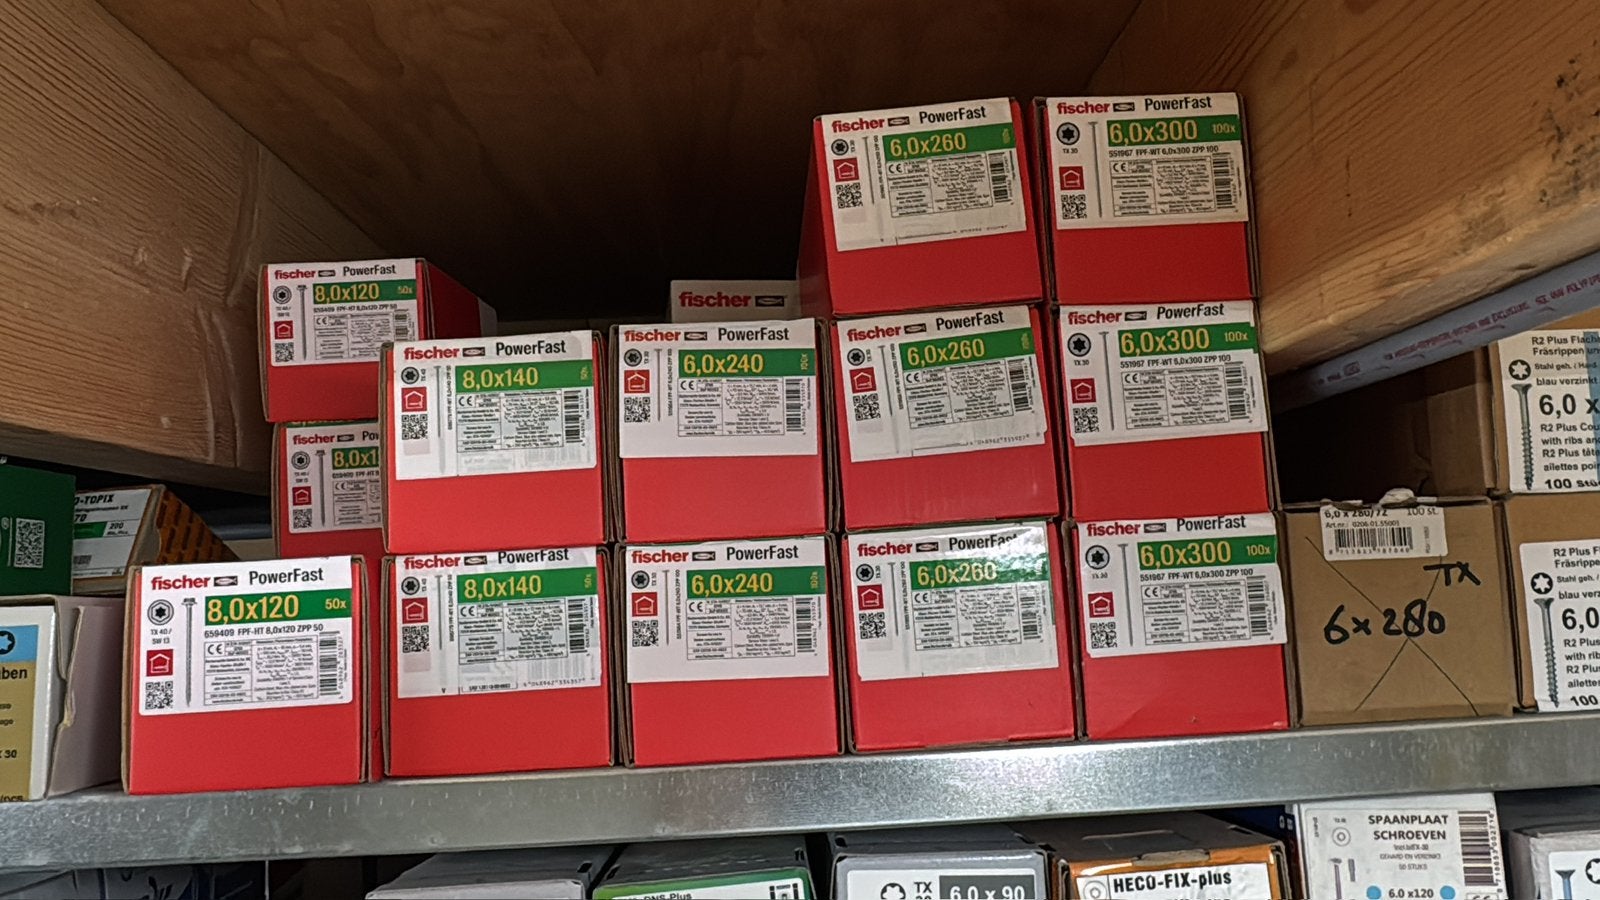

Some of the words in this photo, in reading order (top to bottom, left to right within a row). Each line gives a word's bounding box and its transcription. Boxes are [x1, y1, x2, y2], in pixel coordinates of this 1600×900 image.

[1057, 102, 1110, 114] fischer
[1145, 97, 1212, 111] PowerFast
[832, 118, 885, 133] fischer
[919, 107, 986, 124] PowerFast
[1109, 120, 1197, 146] 6,0x300
[1212, 123, 1235, 133] 100x
[890, 132, 966, 159] 6,0x260
[275, 269, 316, 279] fischer
[343, 265, 396, 276] PowerFast
[315, 283, 379, 303] 8,0x120
[679, 292, 751, 307] fischer
[1068, 311, 1122, 325] fischer
[1157, 304, 1224, 319] PowerFast
[847, 326, 901, 341] fischer
[936, 311, 1004, 330] PowerFast
[624, 330, 681, 341] fischer
[718, 328, 789, 341] PowerFast
[1532, 337, 1544, 345] R2
[1547, 336, 1568, 344] Plus
[404, 347, 459, 360] fischer
[496, 340, 566, 355] PowerFast
[1121, 328, 1210, 357] 6,0x300
[1224, 332, 1248, 342] 100x
[907, 339, 985, 366] 6,0x260
[1533, 347, 1584, 357] Fräsrippen
[684, 354, 763, 376] 6,0x240
[1204, 356, 1217, 364] ZPP
[463, 367, 538, 390] 8,0x140
[1559, 377, 1597, 385] verzinkt
[1539, 394, 1576, 418] 6,0
[1585, 399, 1599, 414] x
[1540, 424, 1553, 432] R2
[1556, 423, 1577, 431] Plus
[293, 434, 335, 445] fischer
[1541, 437, 1562, 445] with
[334, 449, 379, 468] 8,0x1
[1542, 449, 1555, 457] R2
[1559, 449, 1579, 457] Plus
[1544, 463, 1578, 471] ailettes
[1545, 479, 1572, 489] 100
[1324, 510, 1340, 519] 6,0
[1408, 507, 1424, 516] 100
[1087, 523, 1140, 536] fischer
[1177, 516, 1246, 532] PowerFast
[632, 550, 689, 563] fischer
[726, 545, 799, 560] PowerFast
[857, 542, 912, 557] fischer
[1141, 541, 1231, 569] 6,0x300
[1247, 545, 1270, 556] 100x
[1553, 548, 1566, 557] R2
[1569, 547, 1590, 556] Plus
[404, 555, 461, 570] fischer
[498, 549, 569, 564] PowerFast
[151, 575, 210, 590] fischer
[250, 568, 323, 585] PowerFast
[917, 562, 998, 588] 6,0x260
[1168, 572, 1193, 580] FPF-WT
[1226, 569, 1239, 577] ZPP
[1241, 568, 1253, 576] 100
[1423, 561, 1481, 586] TX
[1578, 575, 1594, 583] geh.
[464, 575, 541, 601] 8,0x140
[692, 573, 773, 597] 6,0x240
[1559, 590, 1579, 599] blau
[207, 595, 299, 625] 8,0x120
[325, 599, 346, 610] 50x
[1562, 607, 1599, 633] 6,0
[238, 627, 264, 636] FPF-HT
[266, 626, 295, 635] 8,0x120
[297, 624, 312, 633] ZPP
[313, 624, 323, 632] 50
[1564, 639, 1576, 647] R2
[1565, 652, 1586, 660] with
[0, 667, 27, 679] ben
[1566, 665, 1579, 674] R2
[1570, 695, 1598, 706] 100
[1368, 815, 1448, 824] SPAANPLAAT
[1374, 830, 1446, 840] SCHROEVEN
[914, 882, 932, 893] TX
[1113, 871, 1232, 894] HECO-FIX-plus
[1388, 889, 1405, 898] 6.0
[1408, 889, 1434, 898] x120
